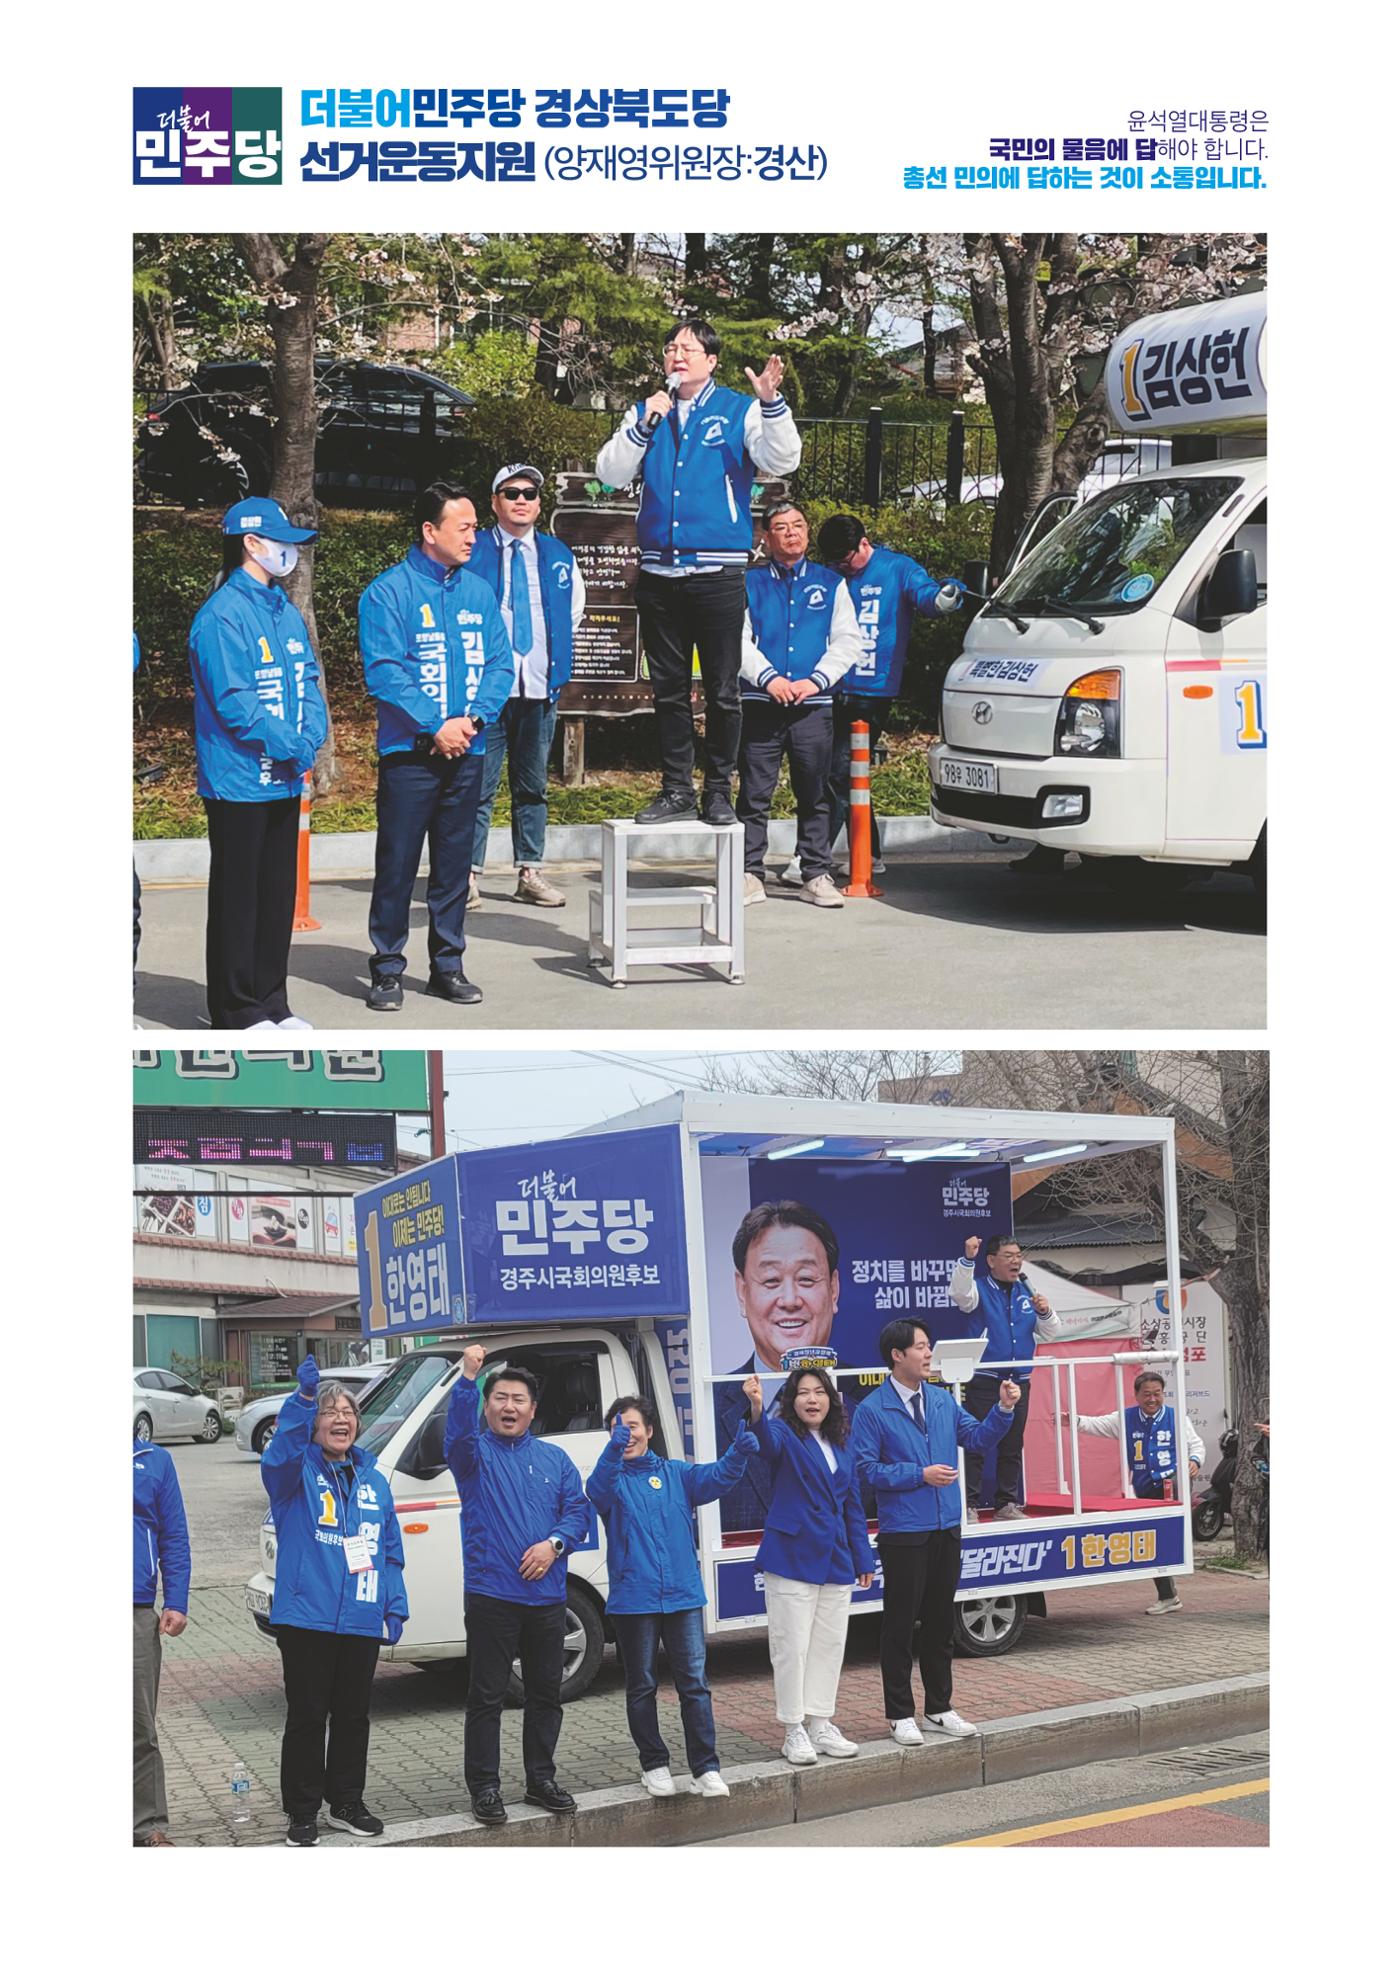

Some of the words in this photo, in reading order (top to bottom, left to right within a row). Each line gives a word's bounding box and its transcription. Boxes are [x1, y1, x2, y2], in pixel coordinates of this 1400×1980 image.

[1119, 338, 1153, 422] 1
[1142, 326, 1253, 412] 김상헌
[280, 551, 287, 567] 1
[419, 603, 436, 628] 1
[258, 636, 275, 664] 1
[460, 631, 485, 717] 김상
[1234, 679, 1267, 750] 1
[966, 766, 989, 789] 3081
[517, 1169, 577, 1204] 더불어
[942, 1187, 990, 1207] 민주당
[416, 1204, 445, 1241] 민주당!
[495, 1199, 654, 1256] 민주당
[364, 1210, 388, 1332] 1
[385, 1241, 450, 1325] 한영태
[500, 1264, 660, 1291] 경주시국회의원후보
[852, 1259, 905, 1284] 정치를
[874, 1286, 910, 1309] 삶이
[1134, 1440, 1144, 1461] 1
[317, 1489, 339, 1527] 1
[1060, 1535, 1076, 1570] 1
[1081, 1530, 1157, 1569] 한영태
